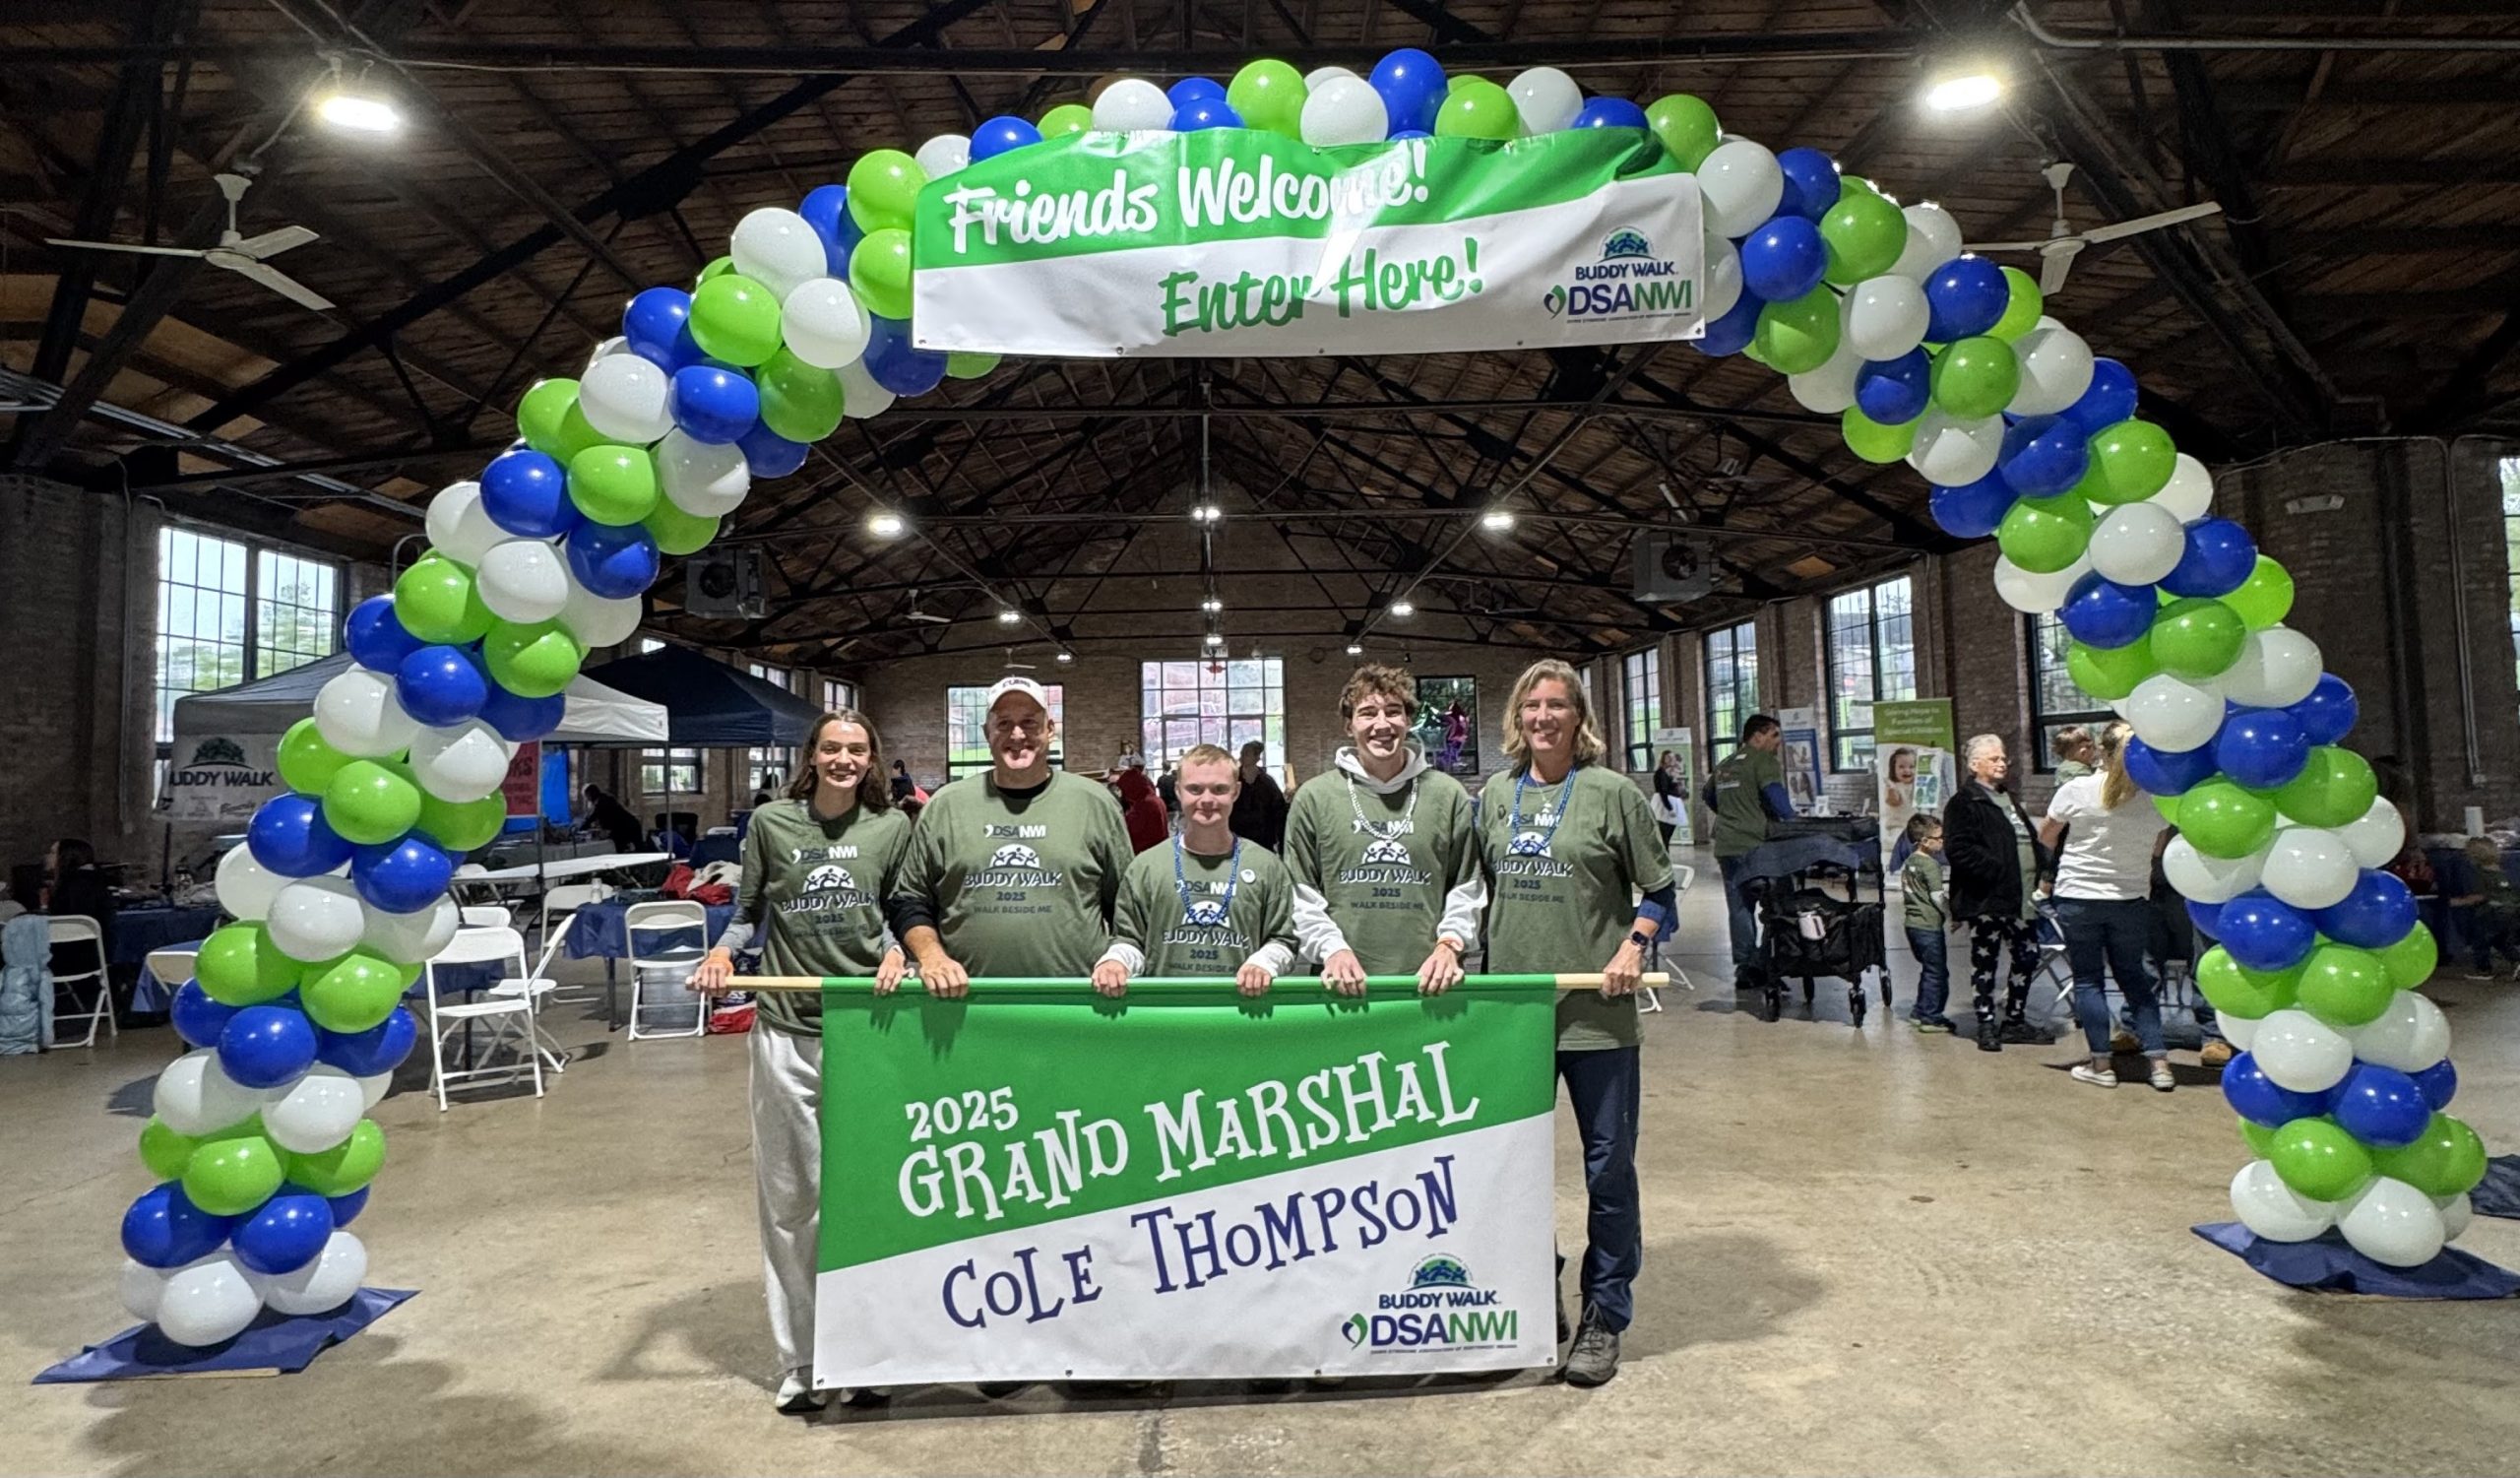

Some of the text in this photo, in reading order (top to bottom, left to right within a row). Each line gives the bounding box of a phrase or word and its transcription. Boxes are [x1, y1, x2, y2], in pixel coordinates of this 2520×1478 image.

[942, 139, 1428, 254] Friends Welcome!
[1575, 261, 1674, 281] BUDDY WALK
[1157, 236, 1483, 338] Enter Here!
[1567, 280, 1692, 316] DSANWI
[222, 771, 275, 787] WALK
[992, 824, 1047, 839] DSANWI
[1361, 820, 1415, 834] SANI
[800, 846, 858, 862] DSANWI
[1339, 868, 1432, 885] BUDDY WALK
[1492, 860, 1574, 877] UDDY WALK
[964, 871, 1062, 887] BUDDY WALK
[1514, 878, 1542, 890] 2025
[833, 890, 875, 908] WALK
[996, 890, 1026, 901] 2025
[1372, 887, 1402, 898] 2025
[815, 913, 845, 925] 2025
[1189, 948, 1219, 960] 2025
[905, 1085, 1019, 1142] 2025
[898, 1040, 1480, 1221] GRAND MARSHAL
[942, 1154, 1457, 1329] COLE THOMPSON
[1378, 1290, 1498, 1310] BUDDY WALK
[1370, 1310, 1518, 1347] DSANWI
